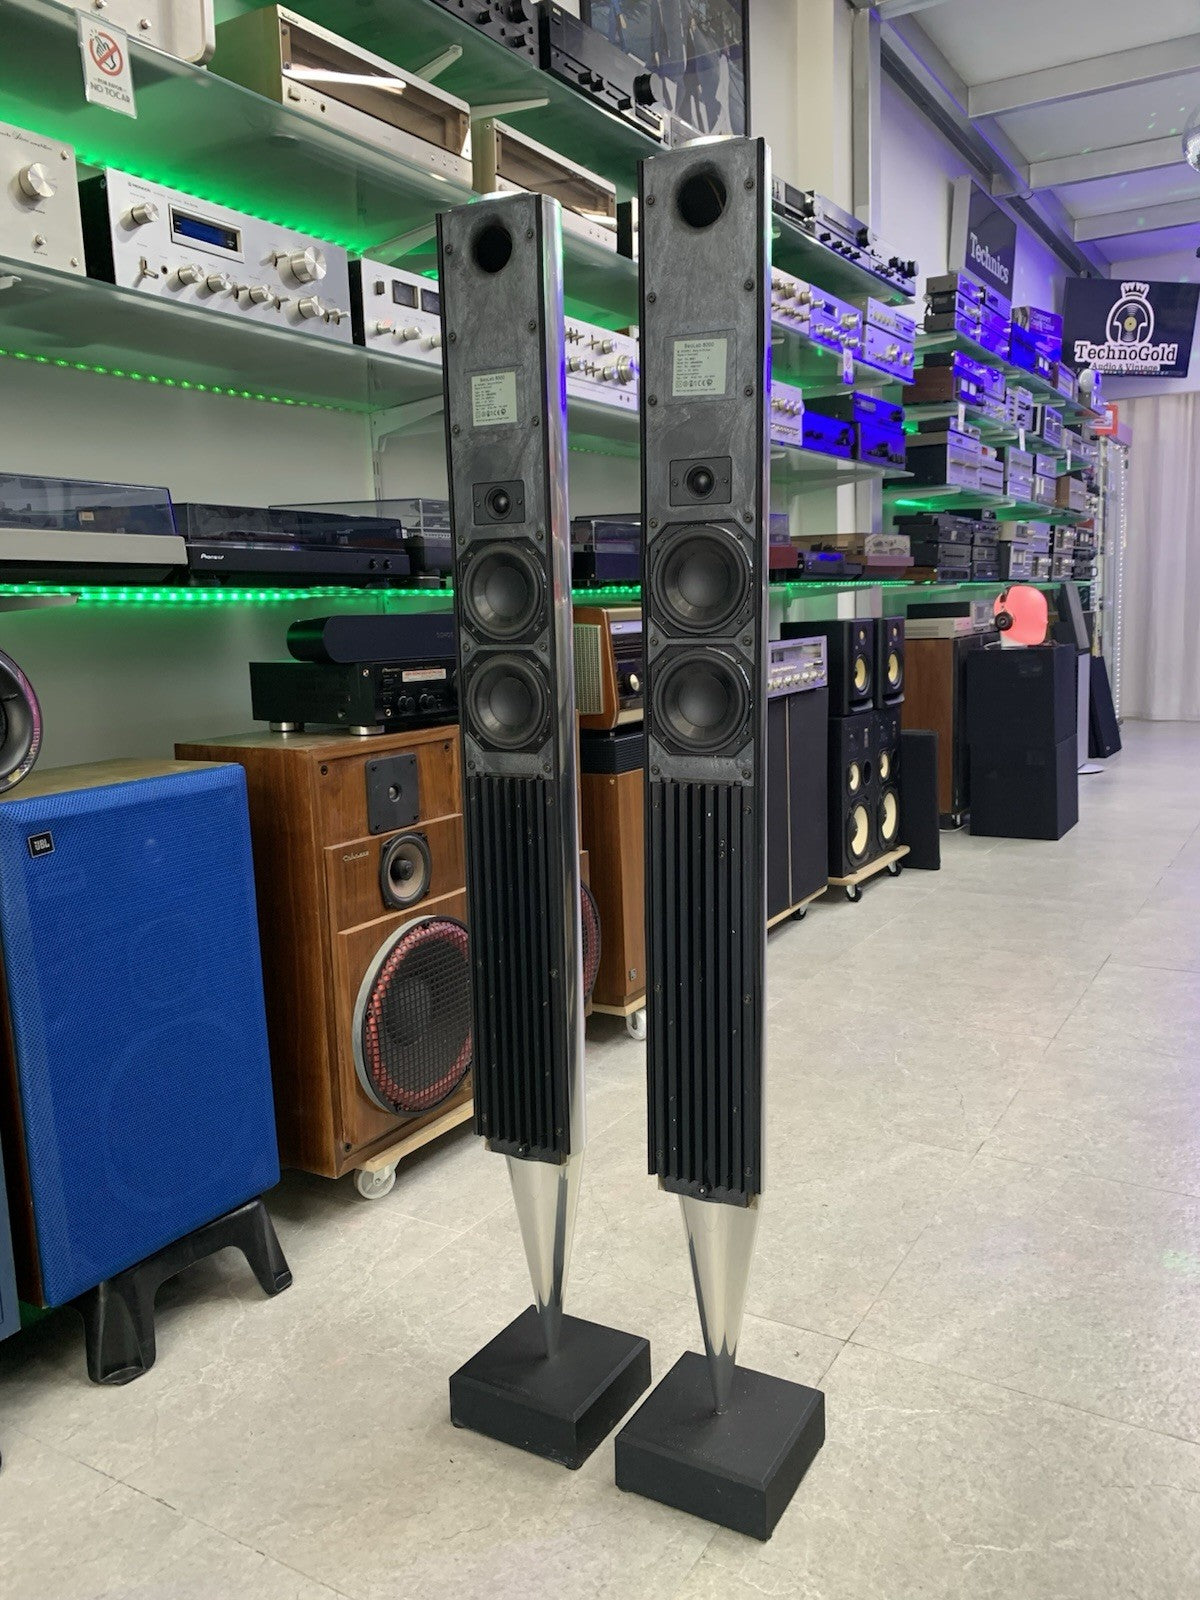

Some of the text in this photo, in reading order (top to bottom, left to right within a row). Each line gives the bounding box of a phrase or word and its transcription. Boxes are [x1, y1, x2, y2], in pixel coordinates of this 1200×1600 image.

[90, 81, 130, 103] NO TOCAR
[970, 231, 1009, 285] Technics
[1076, 343, 1176, 362] TechnoGold
[1091, 362, 1117, 371] Audio
[1125, 362, 1159, 372] Vintage
[34, 839, 50, 850] JBL
